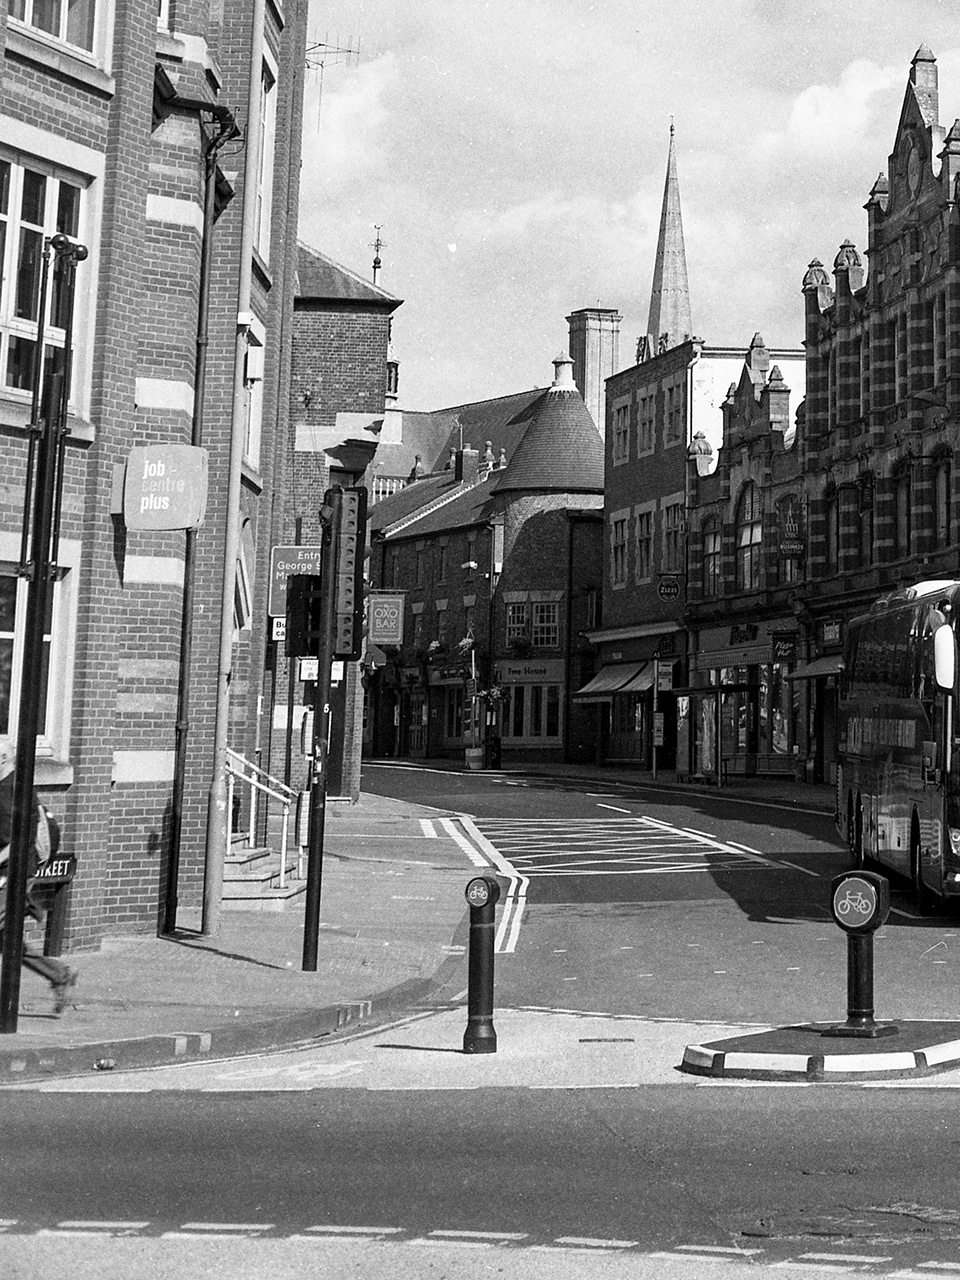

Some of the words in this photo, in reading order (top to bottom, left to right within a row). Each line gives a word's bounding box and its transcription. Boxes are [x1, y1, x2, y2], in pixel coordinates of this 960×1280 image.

[142, 460, 165, 479] job
[142, 478, 185, 492] centre
[140, 493, 170, 514] plus
[277, 561, 312, 572] George
[315, 561, 320, 571] S
[374, 608, 398, 619] OXO
[376, 619, 397, 629] BAR
[774, 641, 793, 650] Pizza
[524, 666, 547, 675] House
